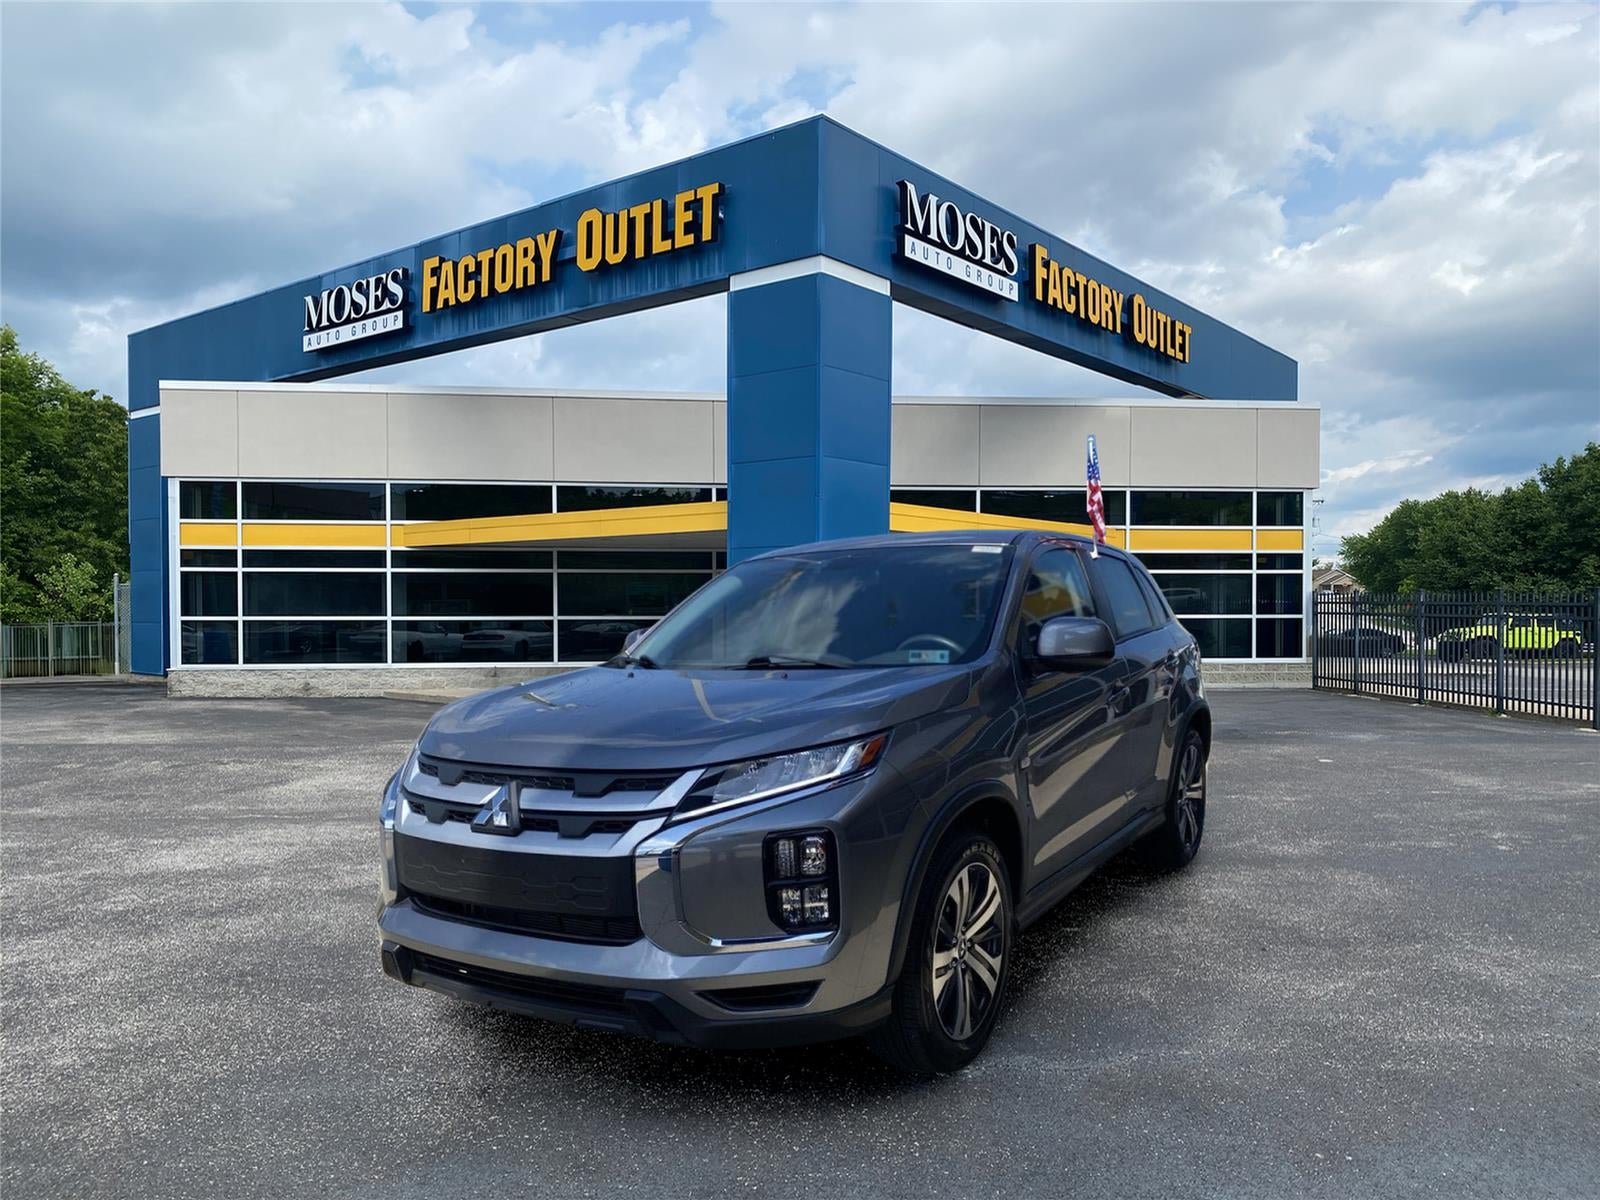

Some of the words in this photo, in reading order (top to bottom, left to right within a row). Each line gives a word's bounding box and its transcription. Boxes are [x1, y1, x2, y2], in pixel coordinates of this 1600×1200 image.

[421, 228, 558, 313] FACTORY
[576, 182, 720, 272] OUTLET
[904, 179, 1018, 277] MOSES
[909, 241, 953, 271] AUTO
[965, 265, 1015, 295] GROUP
[302, 267, 404, 331] MOSES
[306, 332, 341, 348] AUTO
[350, 315, 399, 337] GROUP
[1034, 243, 1124, 334] FACTORY
[1132, 293, 1192, 364] OUTLET
